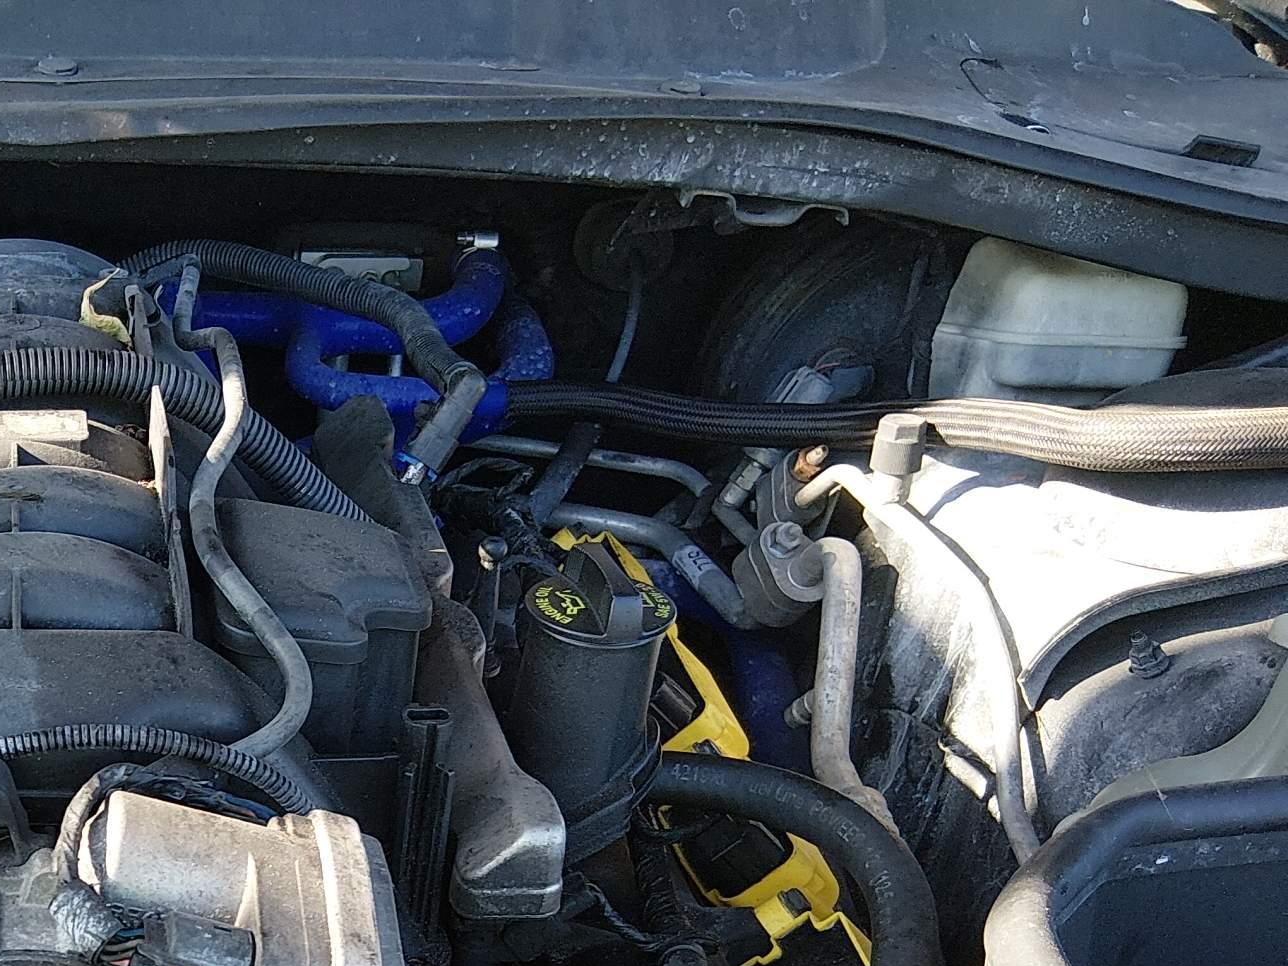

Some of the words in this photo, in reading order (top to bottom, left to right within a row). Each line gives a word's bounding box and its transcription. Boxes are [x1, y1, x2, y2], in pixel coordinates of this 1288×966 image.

[535, 586, 553, 597] OIL
[536, 597, 573, 624] ENGINE
[654, 603, 671, 619] SAE
